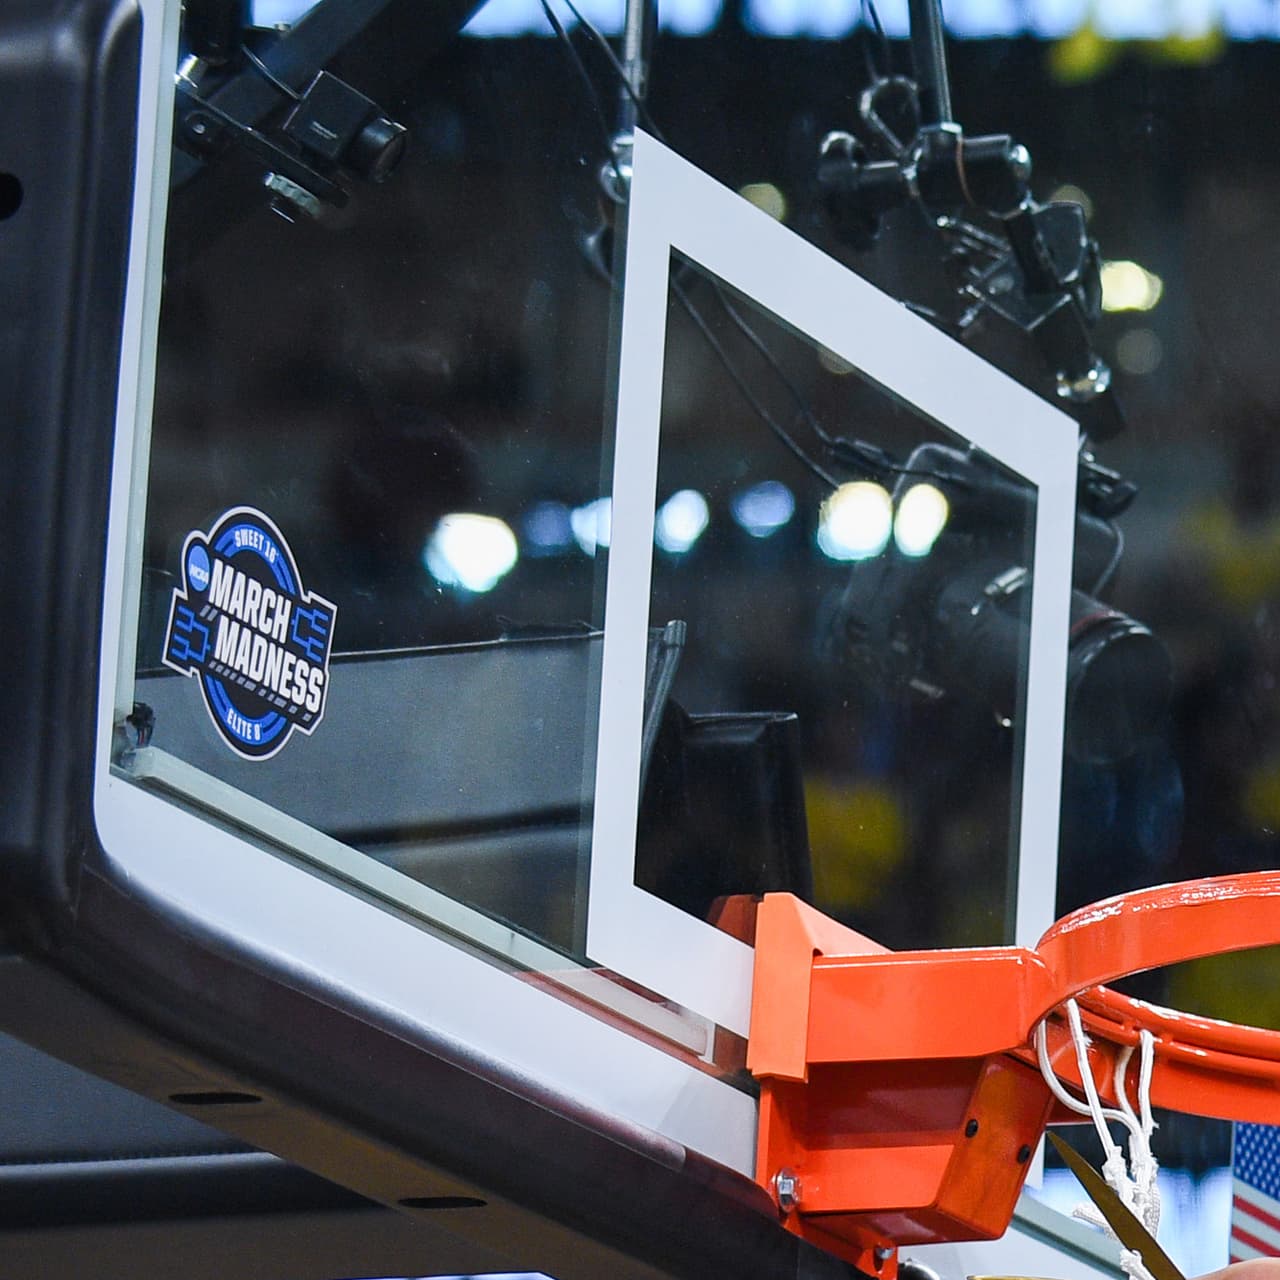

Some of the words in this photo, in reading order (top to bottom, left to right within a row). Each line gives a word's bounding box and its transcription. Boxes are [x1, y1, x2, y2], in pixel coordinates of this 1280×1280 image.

[234, 528, 264, 551] SWEET
[264, 541, 278, 564] 16
[208, 558, 292, 644] MARCH
[214, 615, 324, 713] MADNESS
[226, 707, 252, 740] ELITE
